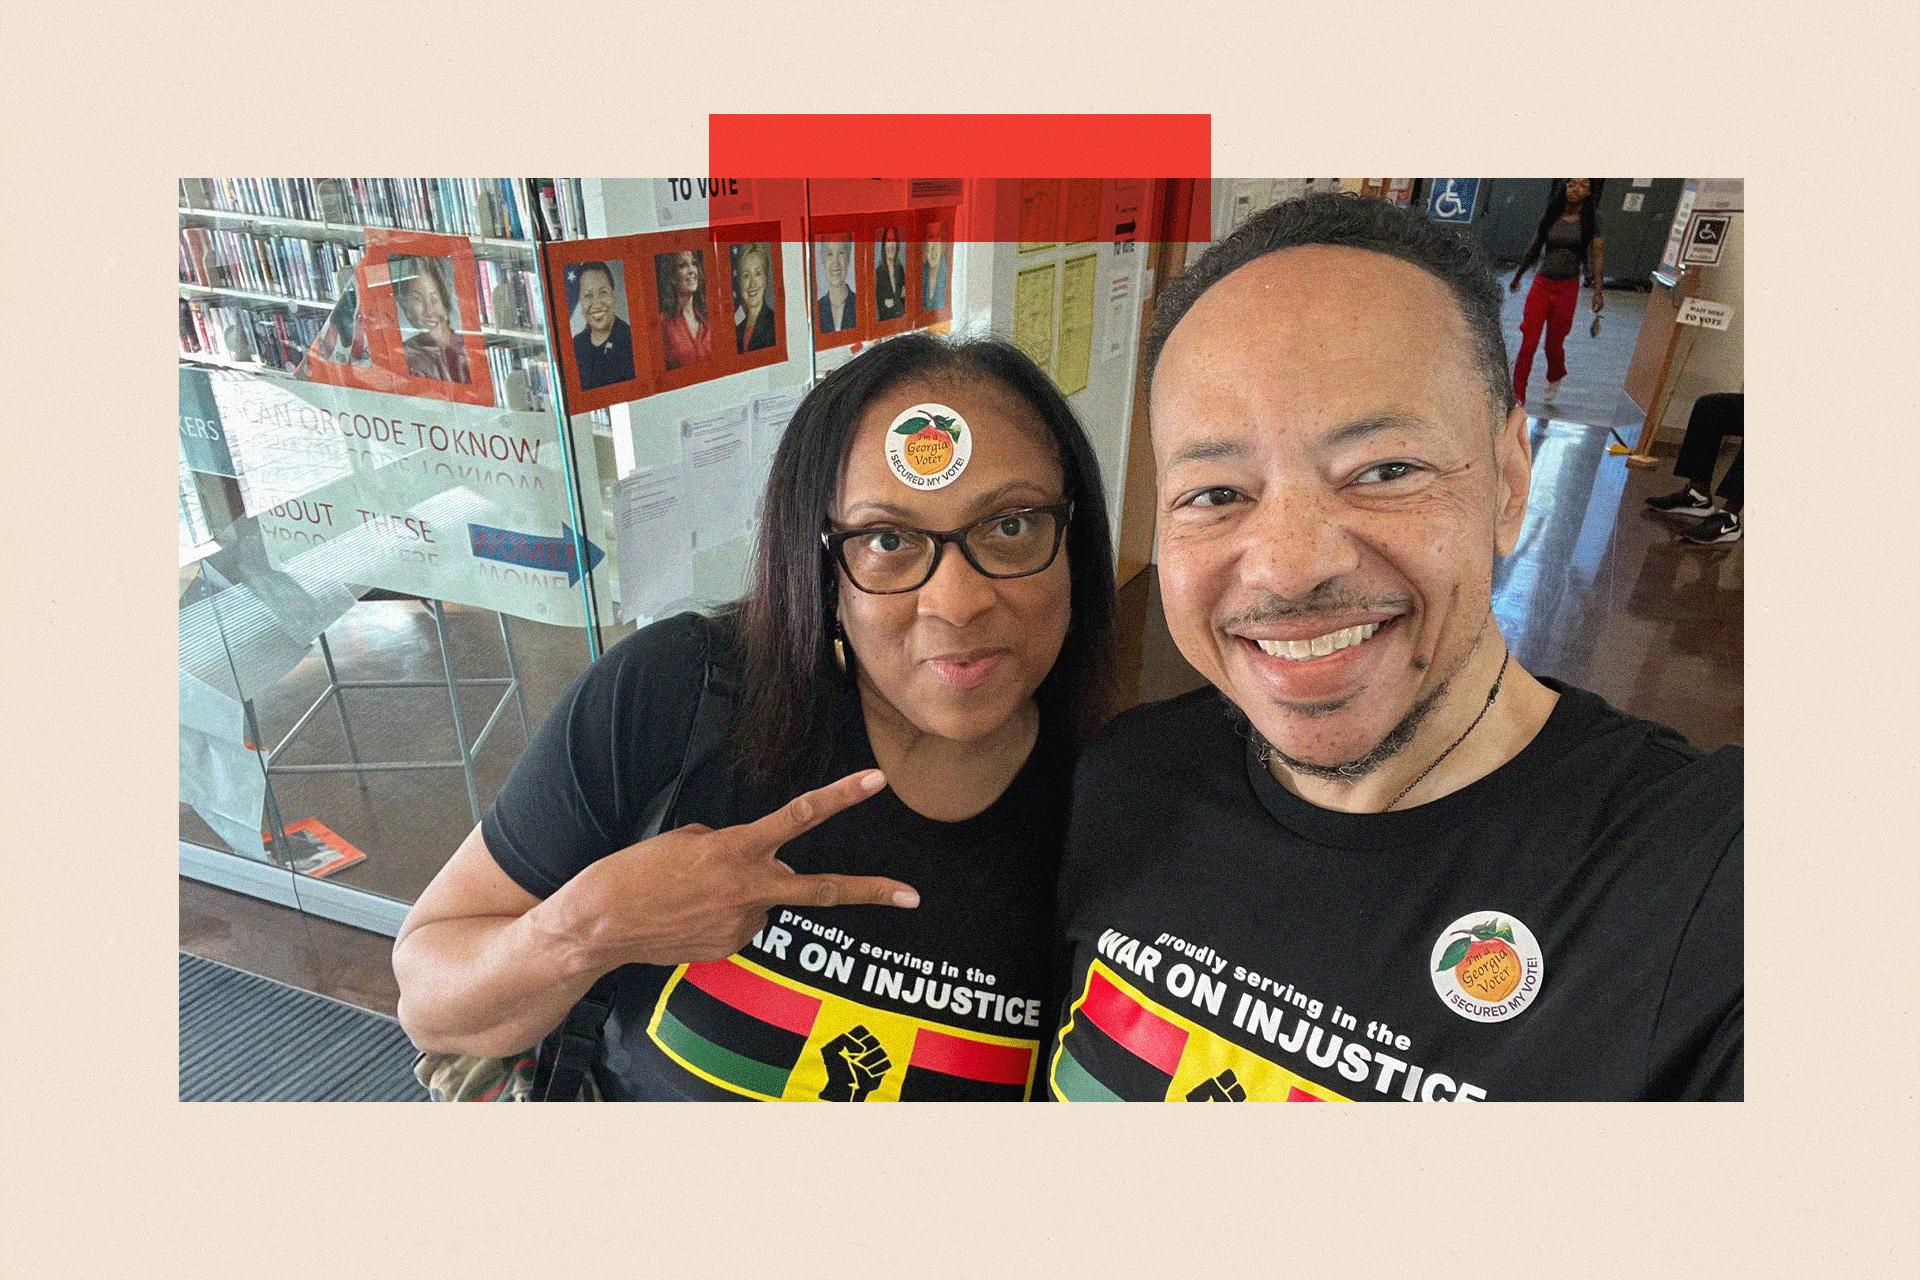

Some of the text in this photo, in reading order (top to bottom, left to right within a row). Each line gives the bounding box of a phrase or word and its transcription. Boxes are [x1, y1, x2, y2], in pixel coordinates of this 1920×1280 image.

[667, 178, 738, 201] TO VOTE
[1685, 313, 1723, 326] TO VOTE
[907, 441, 948, 456] Georgia
[917, 433, 931, 441] I'm
[891, 454, 925, 486] SECURED
[926, 477, 941, 486] MY
[941, 457, 965, 480] VOTE!
[914, 454, 943, 466] Voter
[262, 497, 333, 527] BOUT
[779, 909, 996, 986] proudly serving in the
[1465, 948, 1490, 965] I'm a
[1097, 928, 1162, 983] WAR
[1166, 963, 1228, 1016] ON
[1462, 948, 1508, 988] Georgia
[1477, 966, 1511, 993] Voter
[799, 942, 855, 984] ON
[862, 964, 1042, 1027] INJUSTICE
[1154, 932, 1411, 1051] proudly serving in the
[1445, 957, 1538, 1017] I SECURED MY VOTE!
